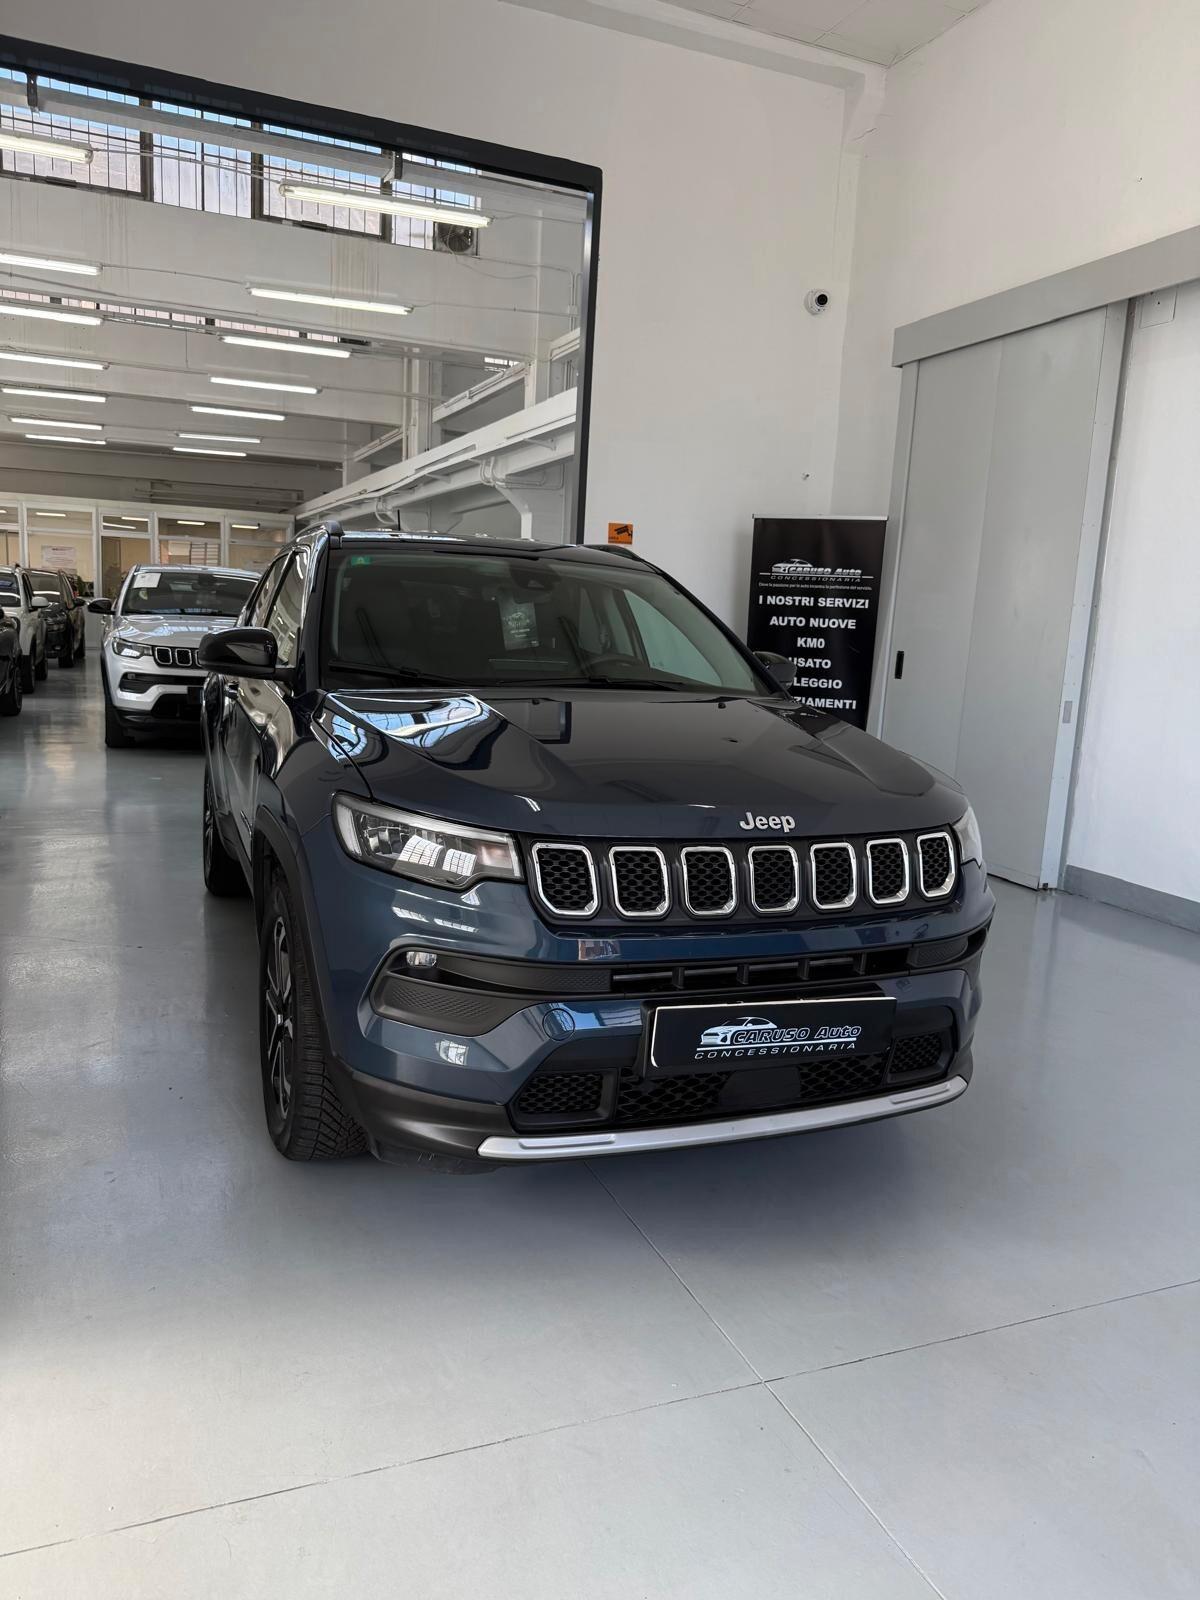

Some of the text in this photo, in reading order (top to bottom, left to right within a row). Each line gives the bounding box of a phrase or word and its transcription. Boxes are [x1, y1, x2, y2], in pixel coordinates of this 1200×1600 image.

[758, 595, 869, 609] I NOSTRI SERVIZI
[769, 616, 857, 629] AUTO NUOVE
[739, 811, 796, 833] Jeep
[732, 1025, 862, 1045] CARUSO Auto
[694, 1042, 856, 1060] CONCESSIONARIA
